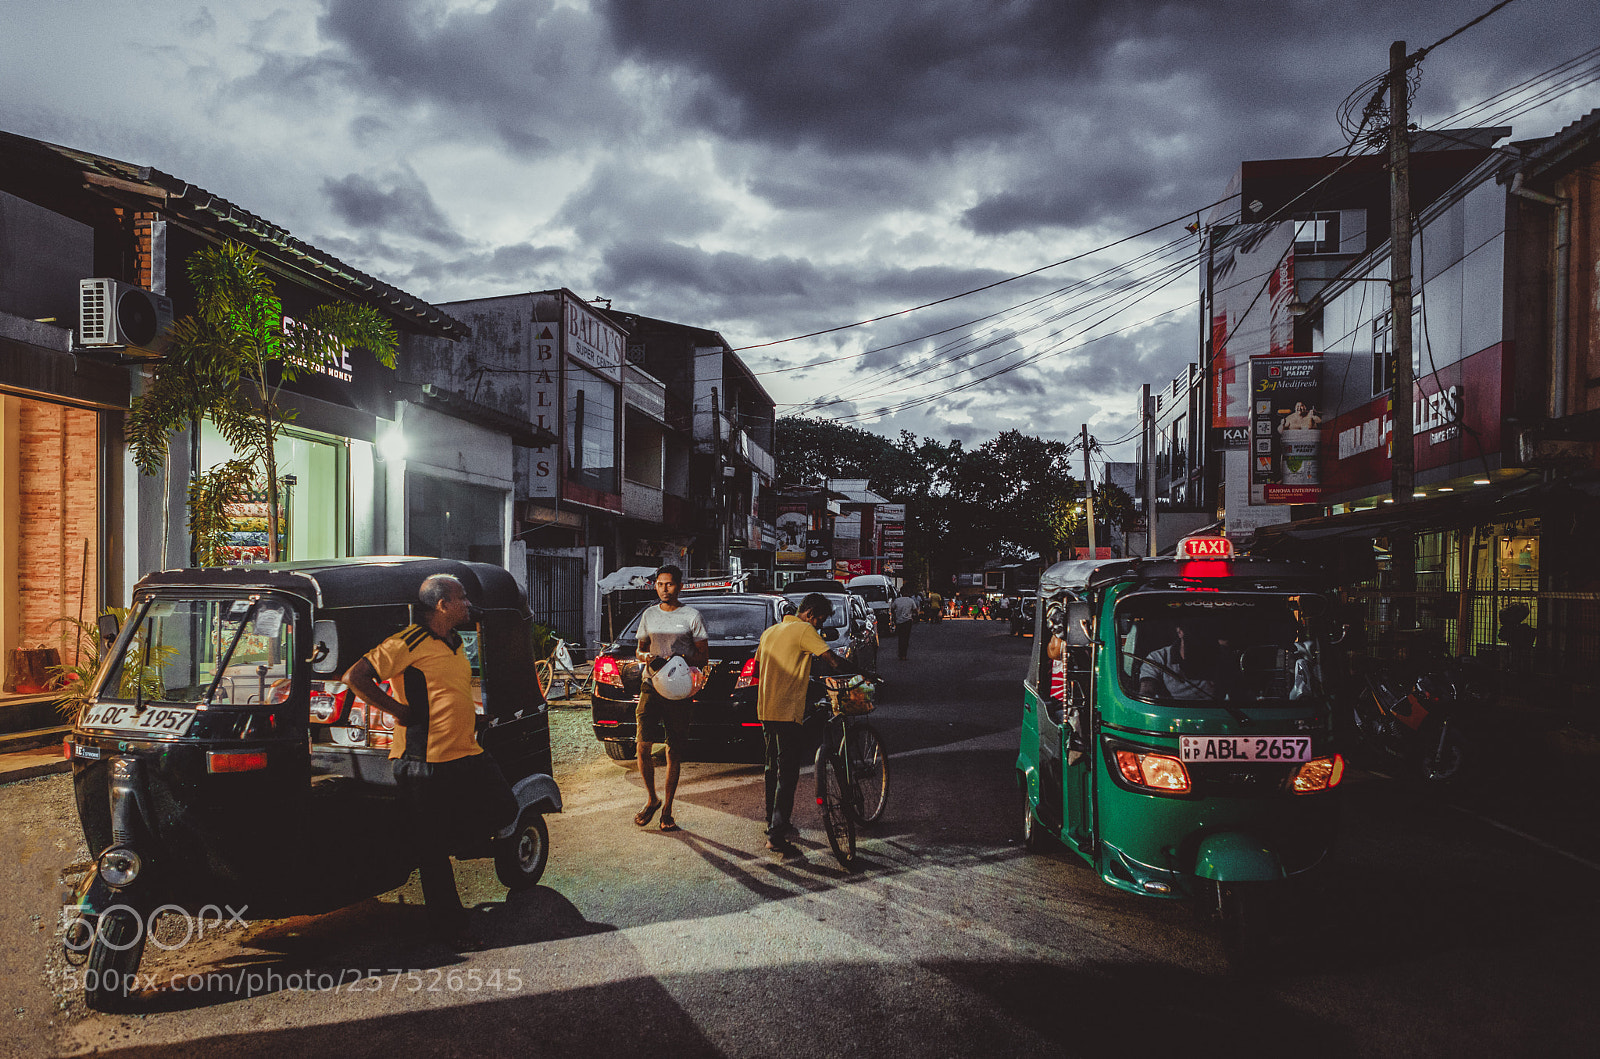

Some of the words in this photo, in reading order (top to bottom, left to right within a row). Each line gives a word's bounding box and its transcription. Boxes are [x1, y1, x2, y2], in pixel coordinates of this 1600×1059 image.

[569, 303, 622, 364] BALLY'S
[576, 341, 596, 362] SUPER
[328, 367, 353, 382] MONEY
[1277, 379, 1318, 390] Medifresh
[535, 344, 553, 477] BALLS
[1190, 540, 1225, 554] TAXI
[100, 706, 128, 724] QC
[140, 708, 193, 731] 1957
[1255, 739, 1309, 760] 2657
